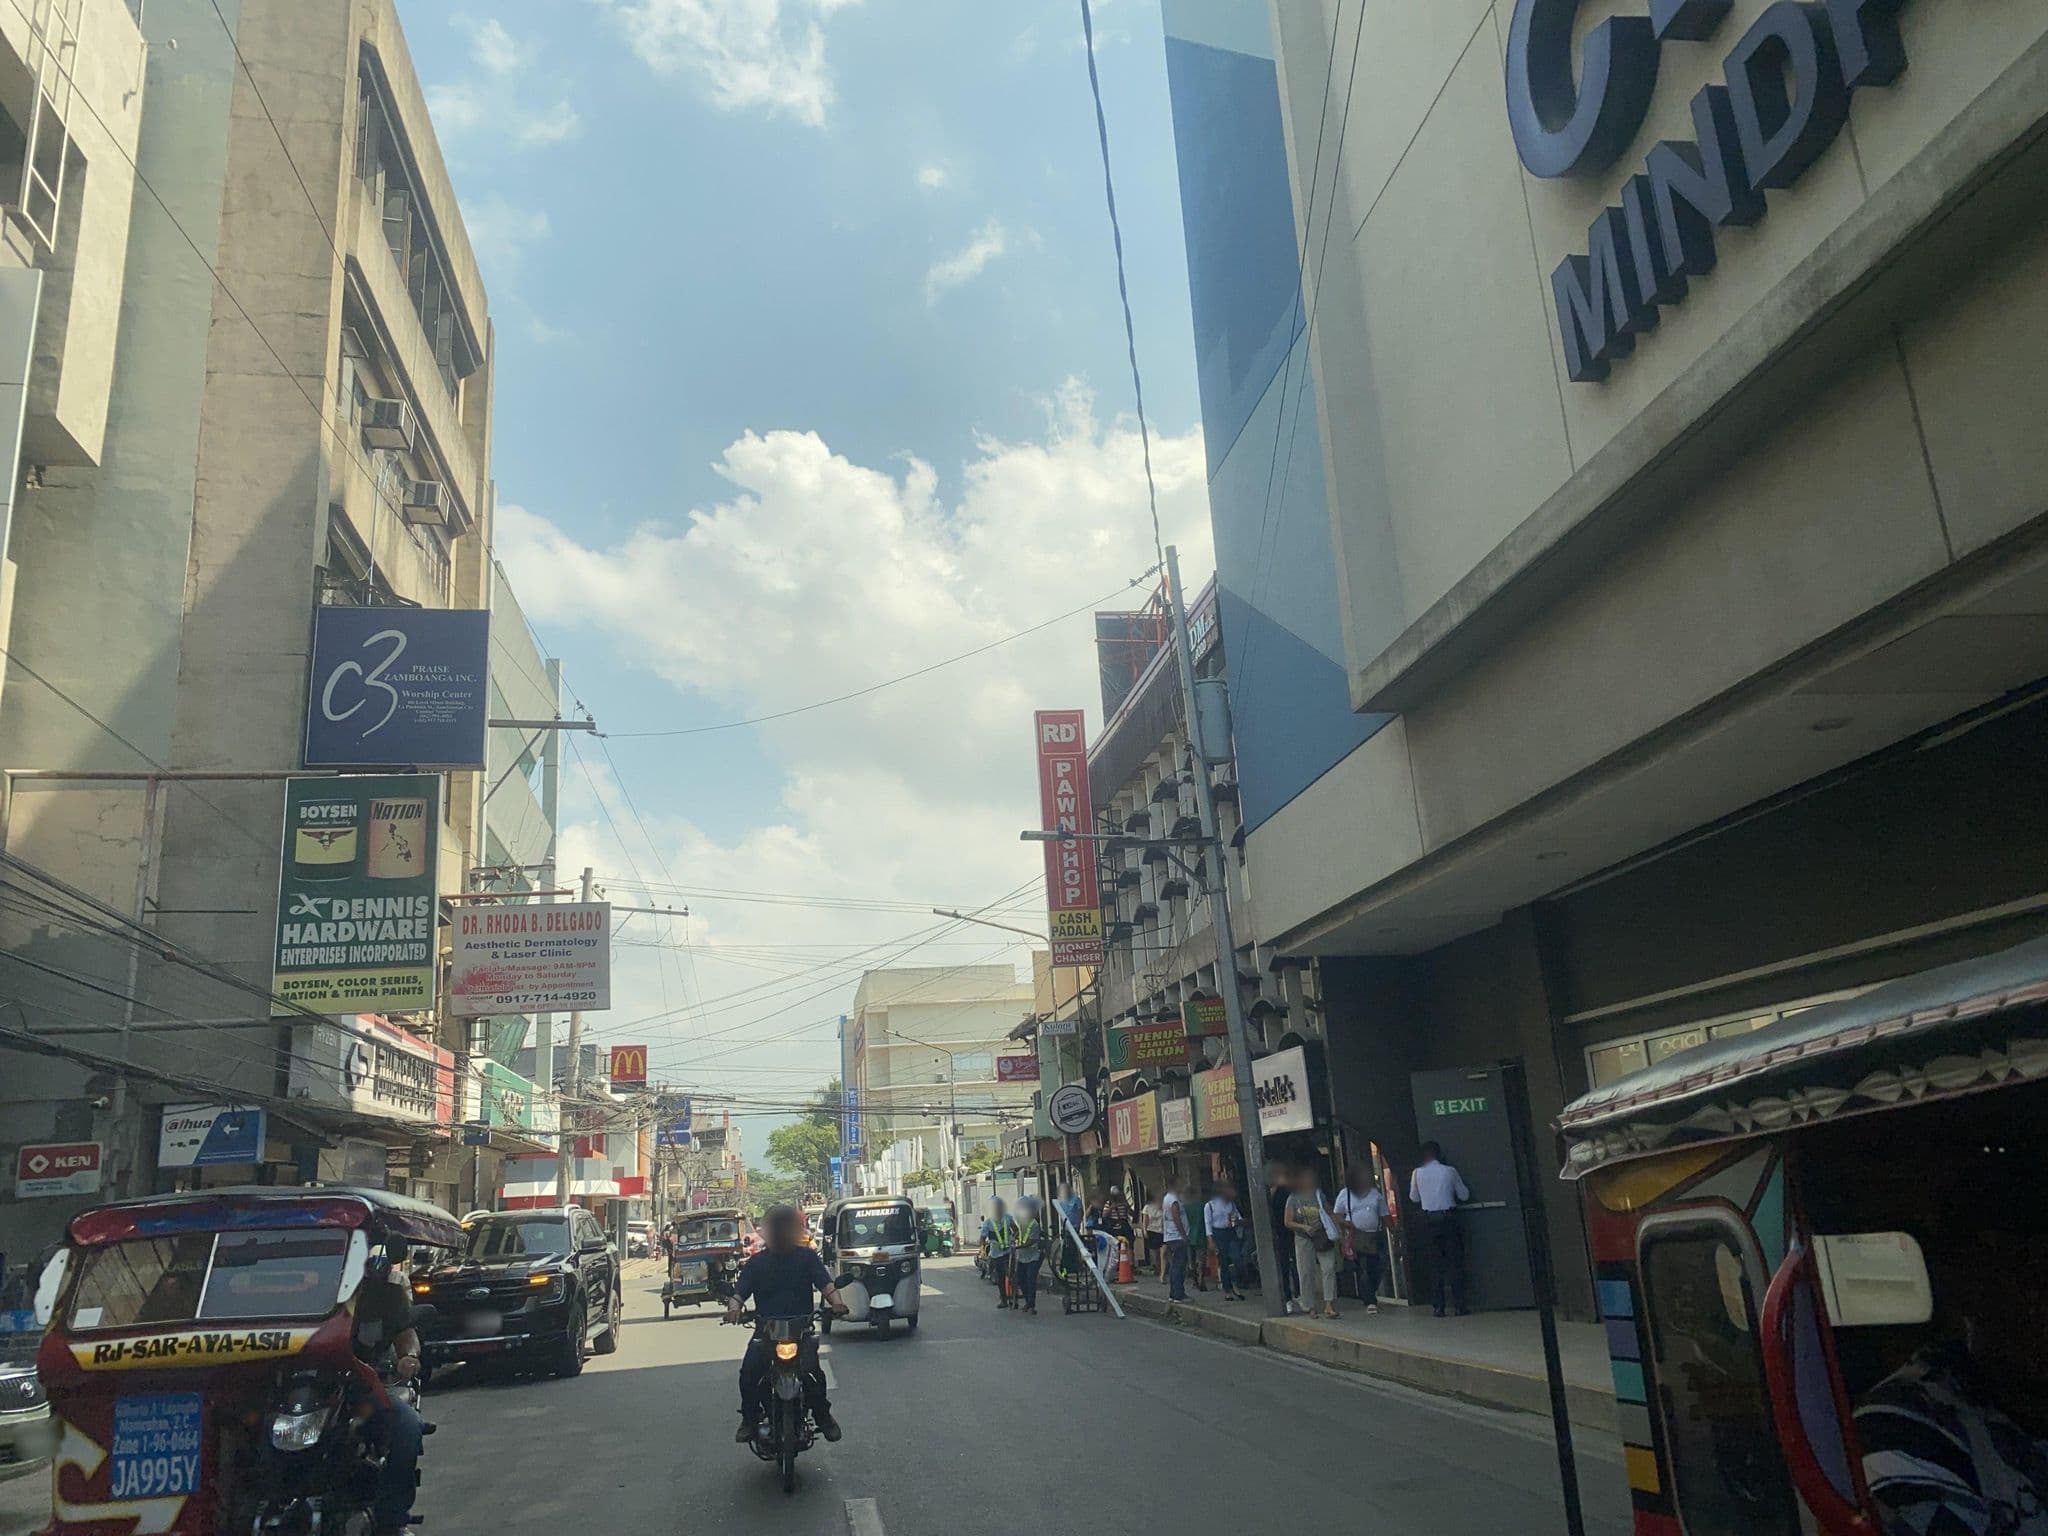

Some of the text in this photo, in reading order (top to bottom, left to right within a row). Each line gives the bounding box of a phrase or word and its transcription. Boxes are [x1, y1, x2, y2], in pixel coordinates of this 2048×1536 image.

[413, 665, 449, 673] PRAISE
[384, 673, 477, 682] ZAMBOANGA INC.
[402, 690, 472, 699] Worship Center
[1042, 723, 1077, 743] RD
[300, 804, 357, 819] BOYSEN
[1056, 761, 1081, 904] PAWNSHOP
[332, 896, 429, 920] DENNIS
[462, 911, 602, 935] DR. RHODA B. DELGADO
[1058, 912, 1092, 925] CASH
[282, 918, 428, 945] HARDWARE
[1052, 924, 1099, 938] PADALA
[464, 938, 598, 950] Aesthetic Dermatology
[1055, 941, 1100, 953] MONEY
[281, 942, 427, 966] ENTERPRISES INCORPORATED
[491, 949, 573, 960] & Laser Clinic
[1055, 952, 1100, 964] CHANGER
[283, 975, 422, 990] BOYSEN, COLOR SERIES,
[486, 973, 522, 981] Monday
[536, 971, 577, 980] Saturday
[529, 983, 540, 991] by
[541, 981, 594, 991] Appointment
[280, 986, 424, 1001] NATION & TITAN PAINTS
[496, 991, 597, 1004] 0917-714-4920
[1134, 1029, 1184, 1042] VENUS
[1140, 1040, 1177, 1048] BEAUTY
[1137, 1046, 1184, 1059] SALON
[1448, 1097, 1486, 1113] EXIT
[1211, 1103, 1239, 1121] SALON
[1116, 1108, 1131, 1146] RD
[55, 1156, 91, 1168] KEN
[93, 1332, 290, 1363] RJ-SAR-AYA-ASH
[112, 1455, 198, 1497] JA995Y
